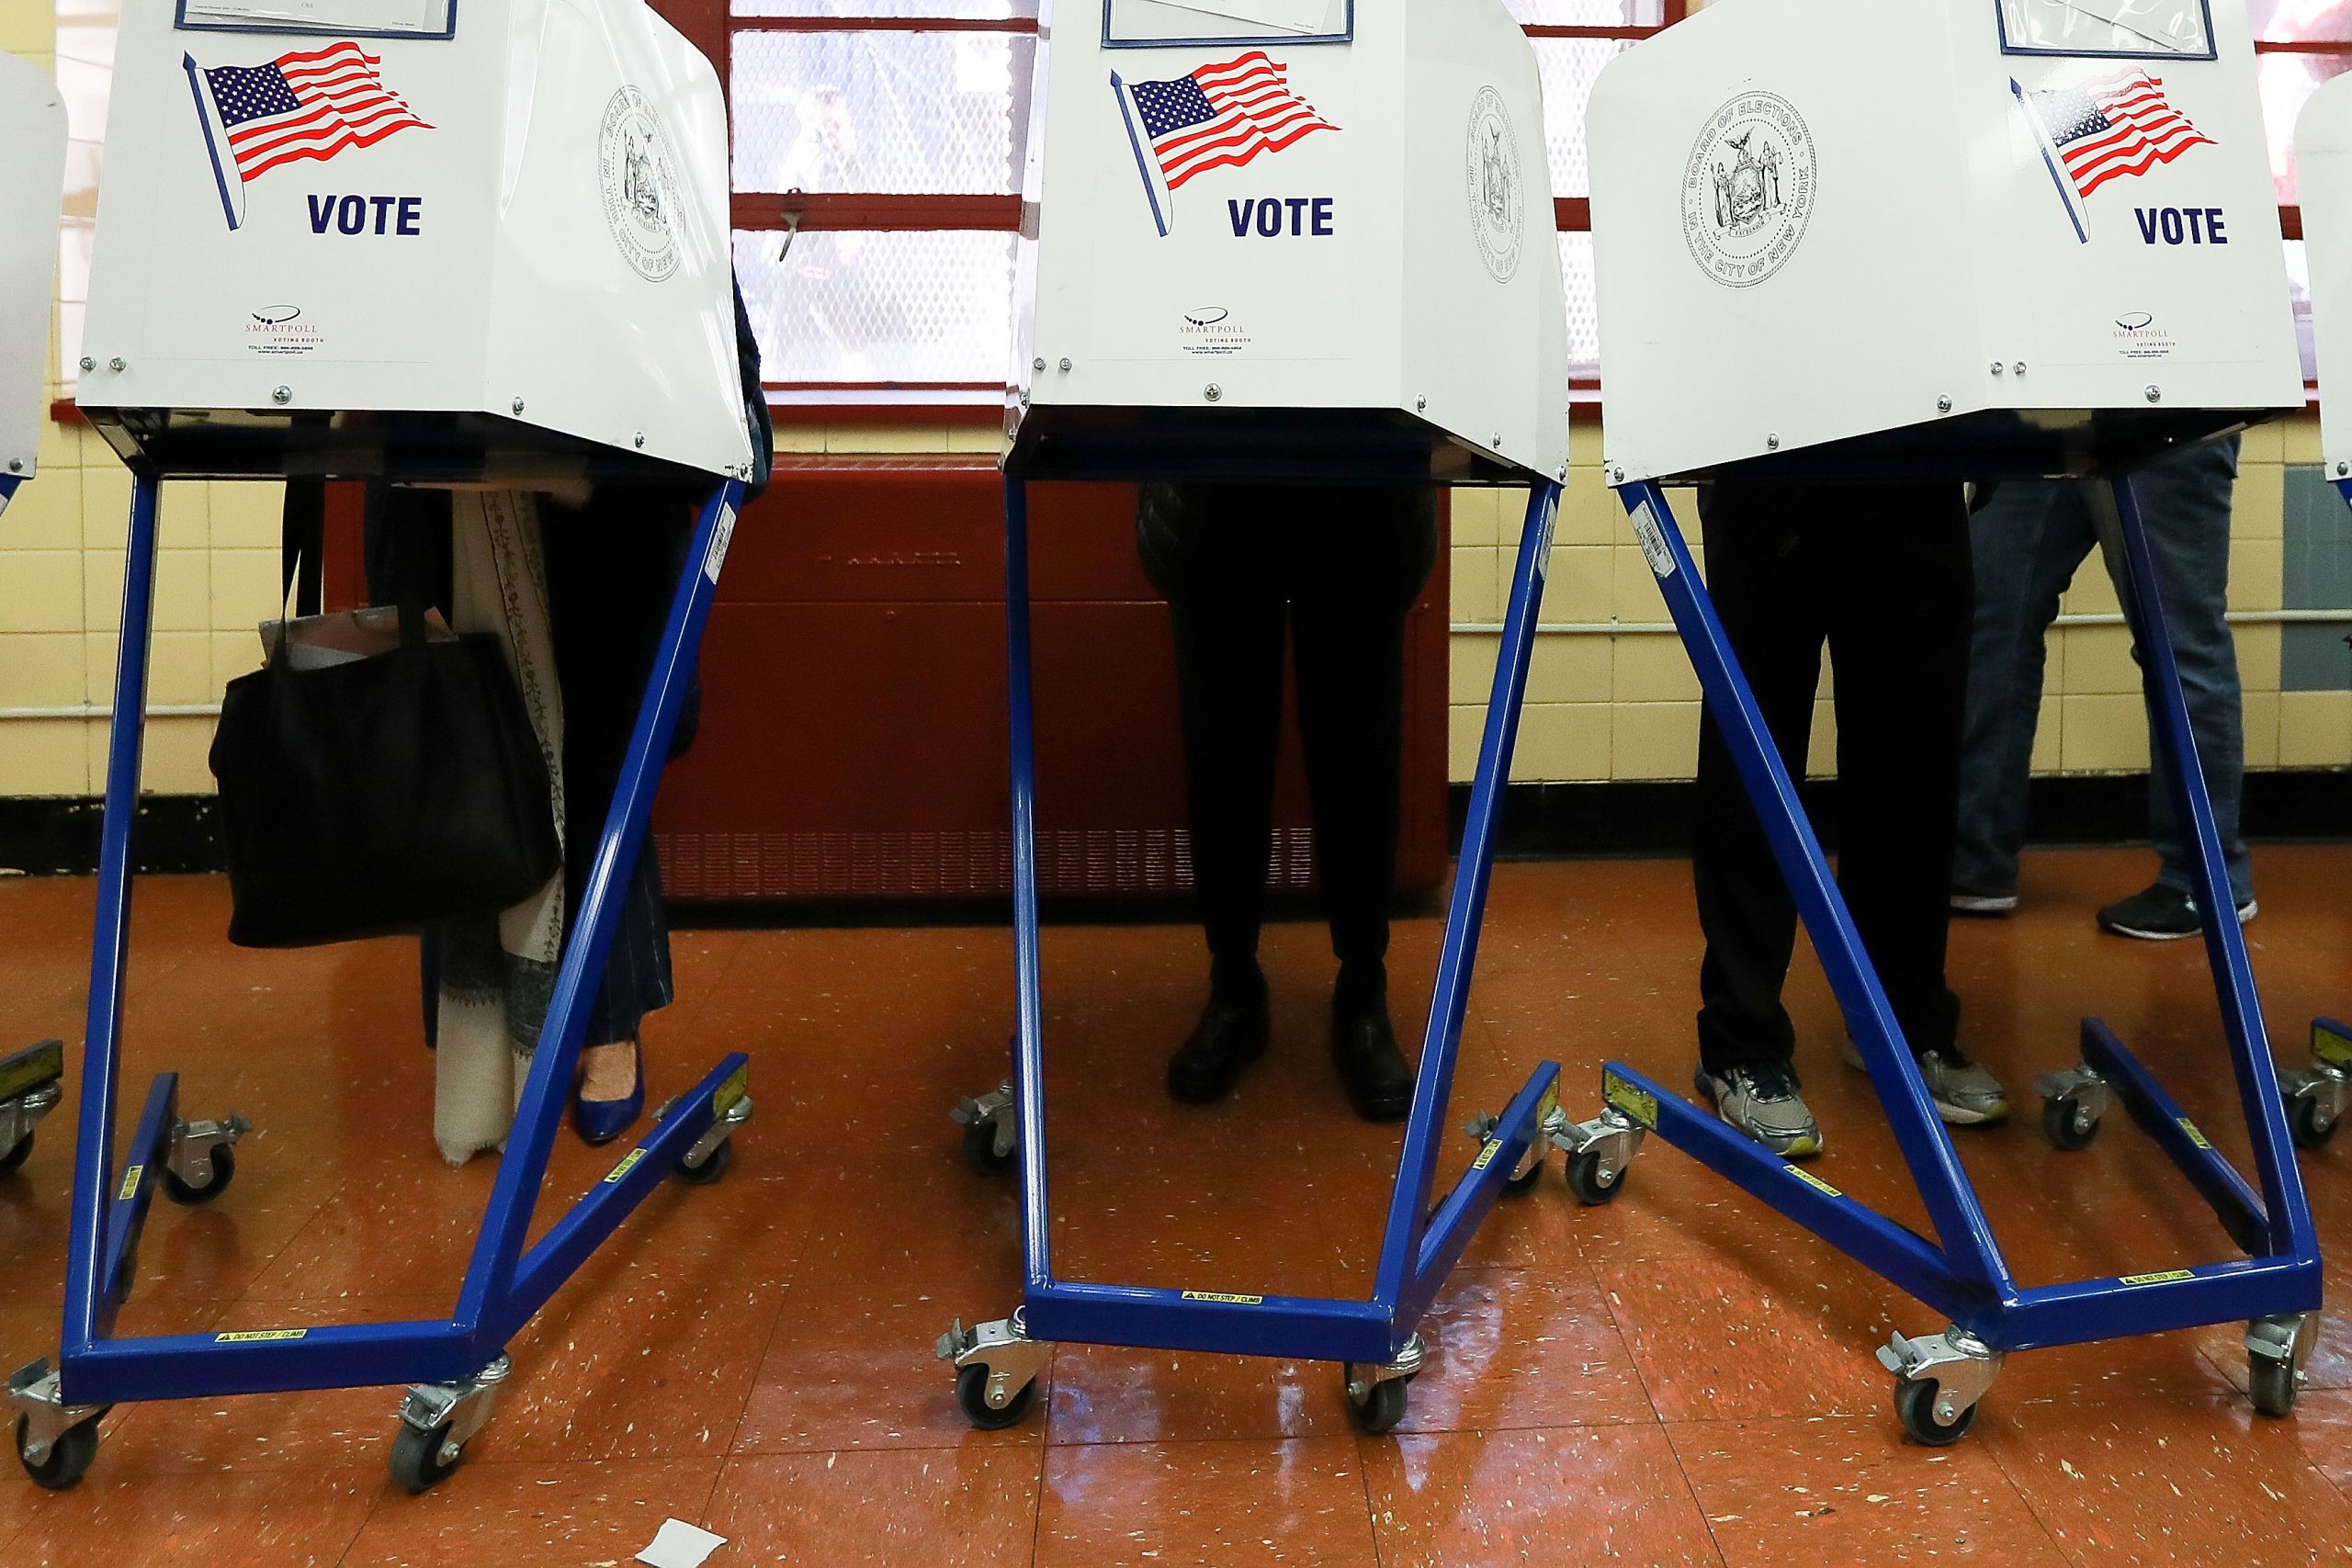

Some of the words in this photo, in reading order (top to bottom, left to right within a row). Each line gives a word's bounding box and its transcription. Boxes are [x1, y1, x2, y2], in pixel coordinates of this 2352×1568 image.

[1689, 128, 1717, 189] BOARD
[1718, 107, 1734, 129] OF
[1737, 100, 1803, 146] ELECTIONS
[308, 195, 422, 236] VOTE
[1228, 198, 1333, 237] VOTE
[1687, 211, 1700, 231] IN
[1694, 231, 1714, 264] THE
[1714, 259, 1745, 277] CITY
[1747, 257, 1766, 276] OF
[1768, 224, 1796, 264] NEW
[1792, 165, 1809, 220] YORK
[2134, 208, 2228, 245] VOTE
[245, 324, 317, 333] SMARTPOLL
[1180, 325, 1245, 333] SMARTPOLL
[2112, 330, 2169, 338] SMARTPOLL
